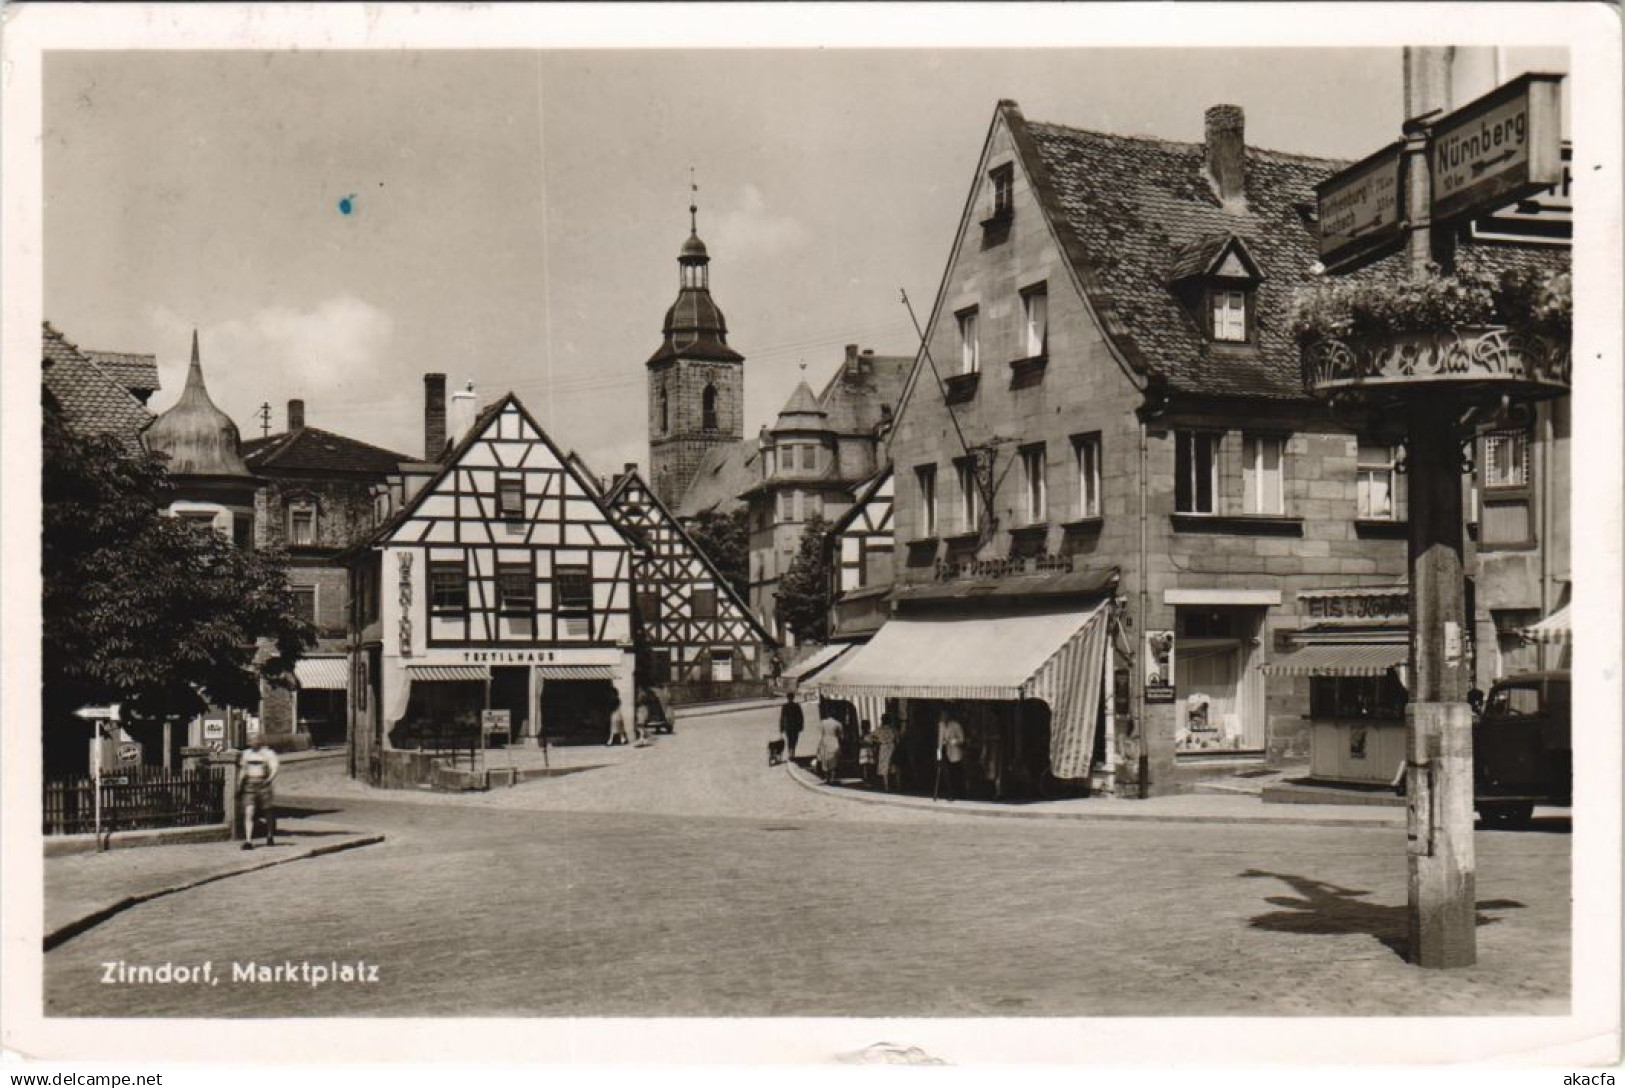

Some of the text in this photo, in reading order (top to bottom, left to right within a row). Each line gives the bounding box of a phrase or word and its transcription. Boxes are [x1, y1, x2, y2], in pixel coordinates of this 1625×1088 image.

[1437, 111, 1526, 174] Nürnberg
[1308, 596, 1343, 618] EIS
[464, 652, 554, 662] TEXTILHAUS
